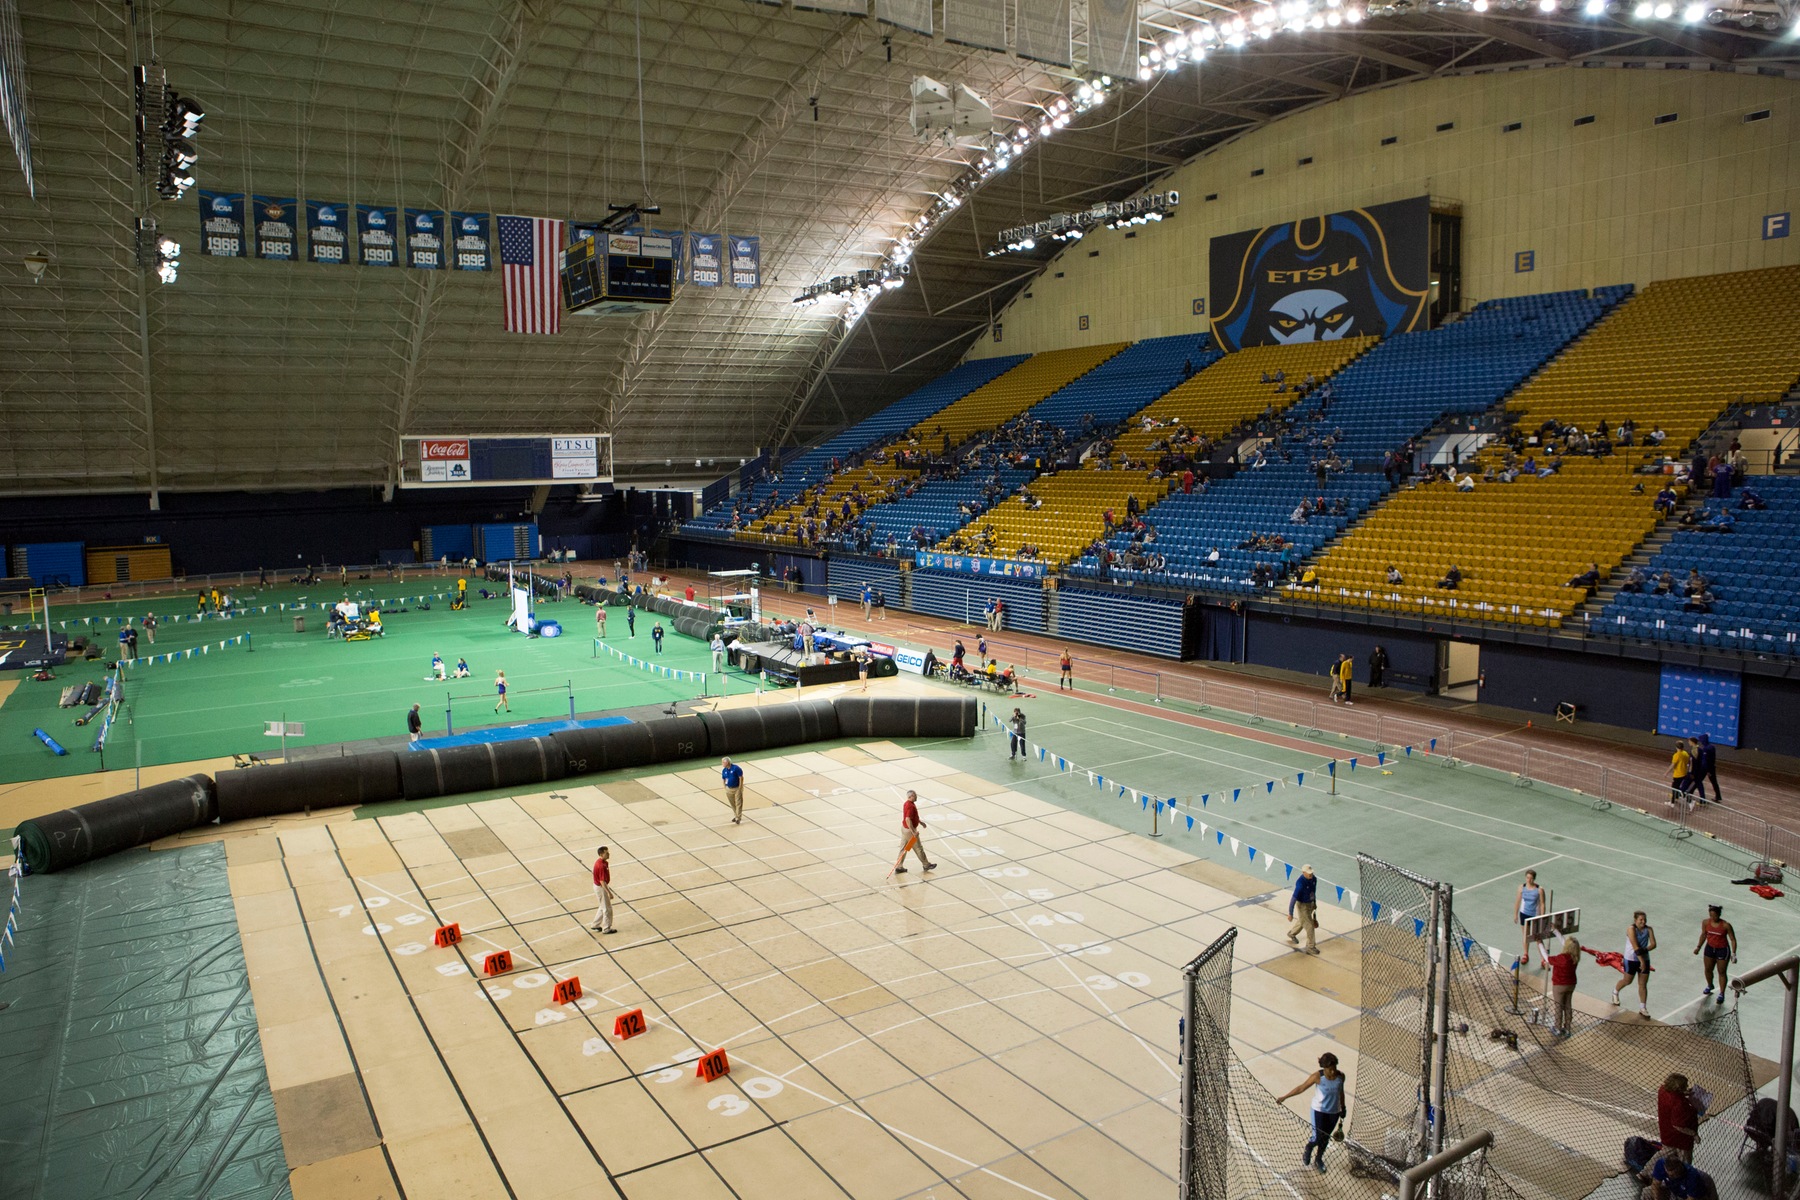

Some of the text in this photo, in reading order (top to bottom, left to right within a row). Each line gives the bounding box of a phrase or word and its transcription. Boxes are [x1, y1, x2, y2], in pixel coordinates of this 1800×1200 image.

[1767, 216, 1785, 237] F
[207, 236, 239, 251] 1968
[261, 241, 292, 255] 1983
[313, 245, 343, 259] 1989
[364, 248, 393, 262] 1990
[413, 251, 438, 265] 1991
[458, 254, 485, 266] 1992
[1519, 253, 1530, 270] E
[693, 270, 718, 282] 2009
[1267, 257, 1359, 283] ETSU
[734, 272, 756, 284] 2010
[1194, 300, 1203, 313] C
[1081, 317, 1088, 328] B
[896, 653, 922, 667] GEICO
[569, 759, 587, 771] P8
[978, 867, 1029, 878] 50
[329, 896, 390, 918] 70
[362, 913, 426, 935] 65
[1027, 911, 1084, 926] 40
[441, 927, 456, 945] 18
[1055, 941, 1112, 957] 35
[490, 954, 507, 972] 16
[474, 973, 549, 1001] 50
[1086, 972, 1151, 990] 30
[560, 981, 576, 1000] 14
[622, 1014, 640, 1036] 12
[706, 1054, 723, 1077] 10
[707, 1076, 783, 1116] 30
